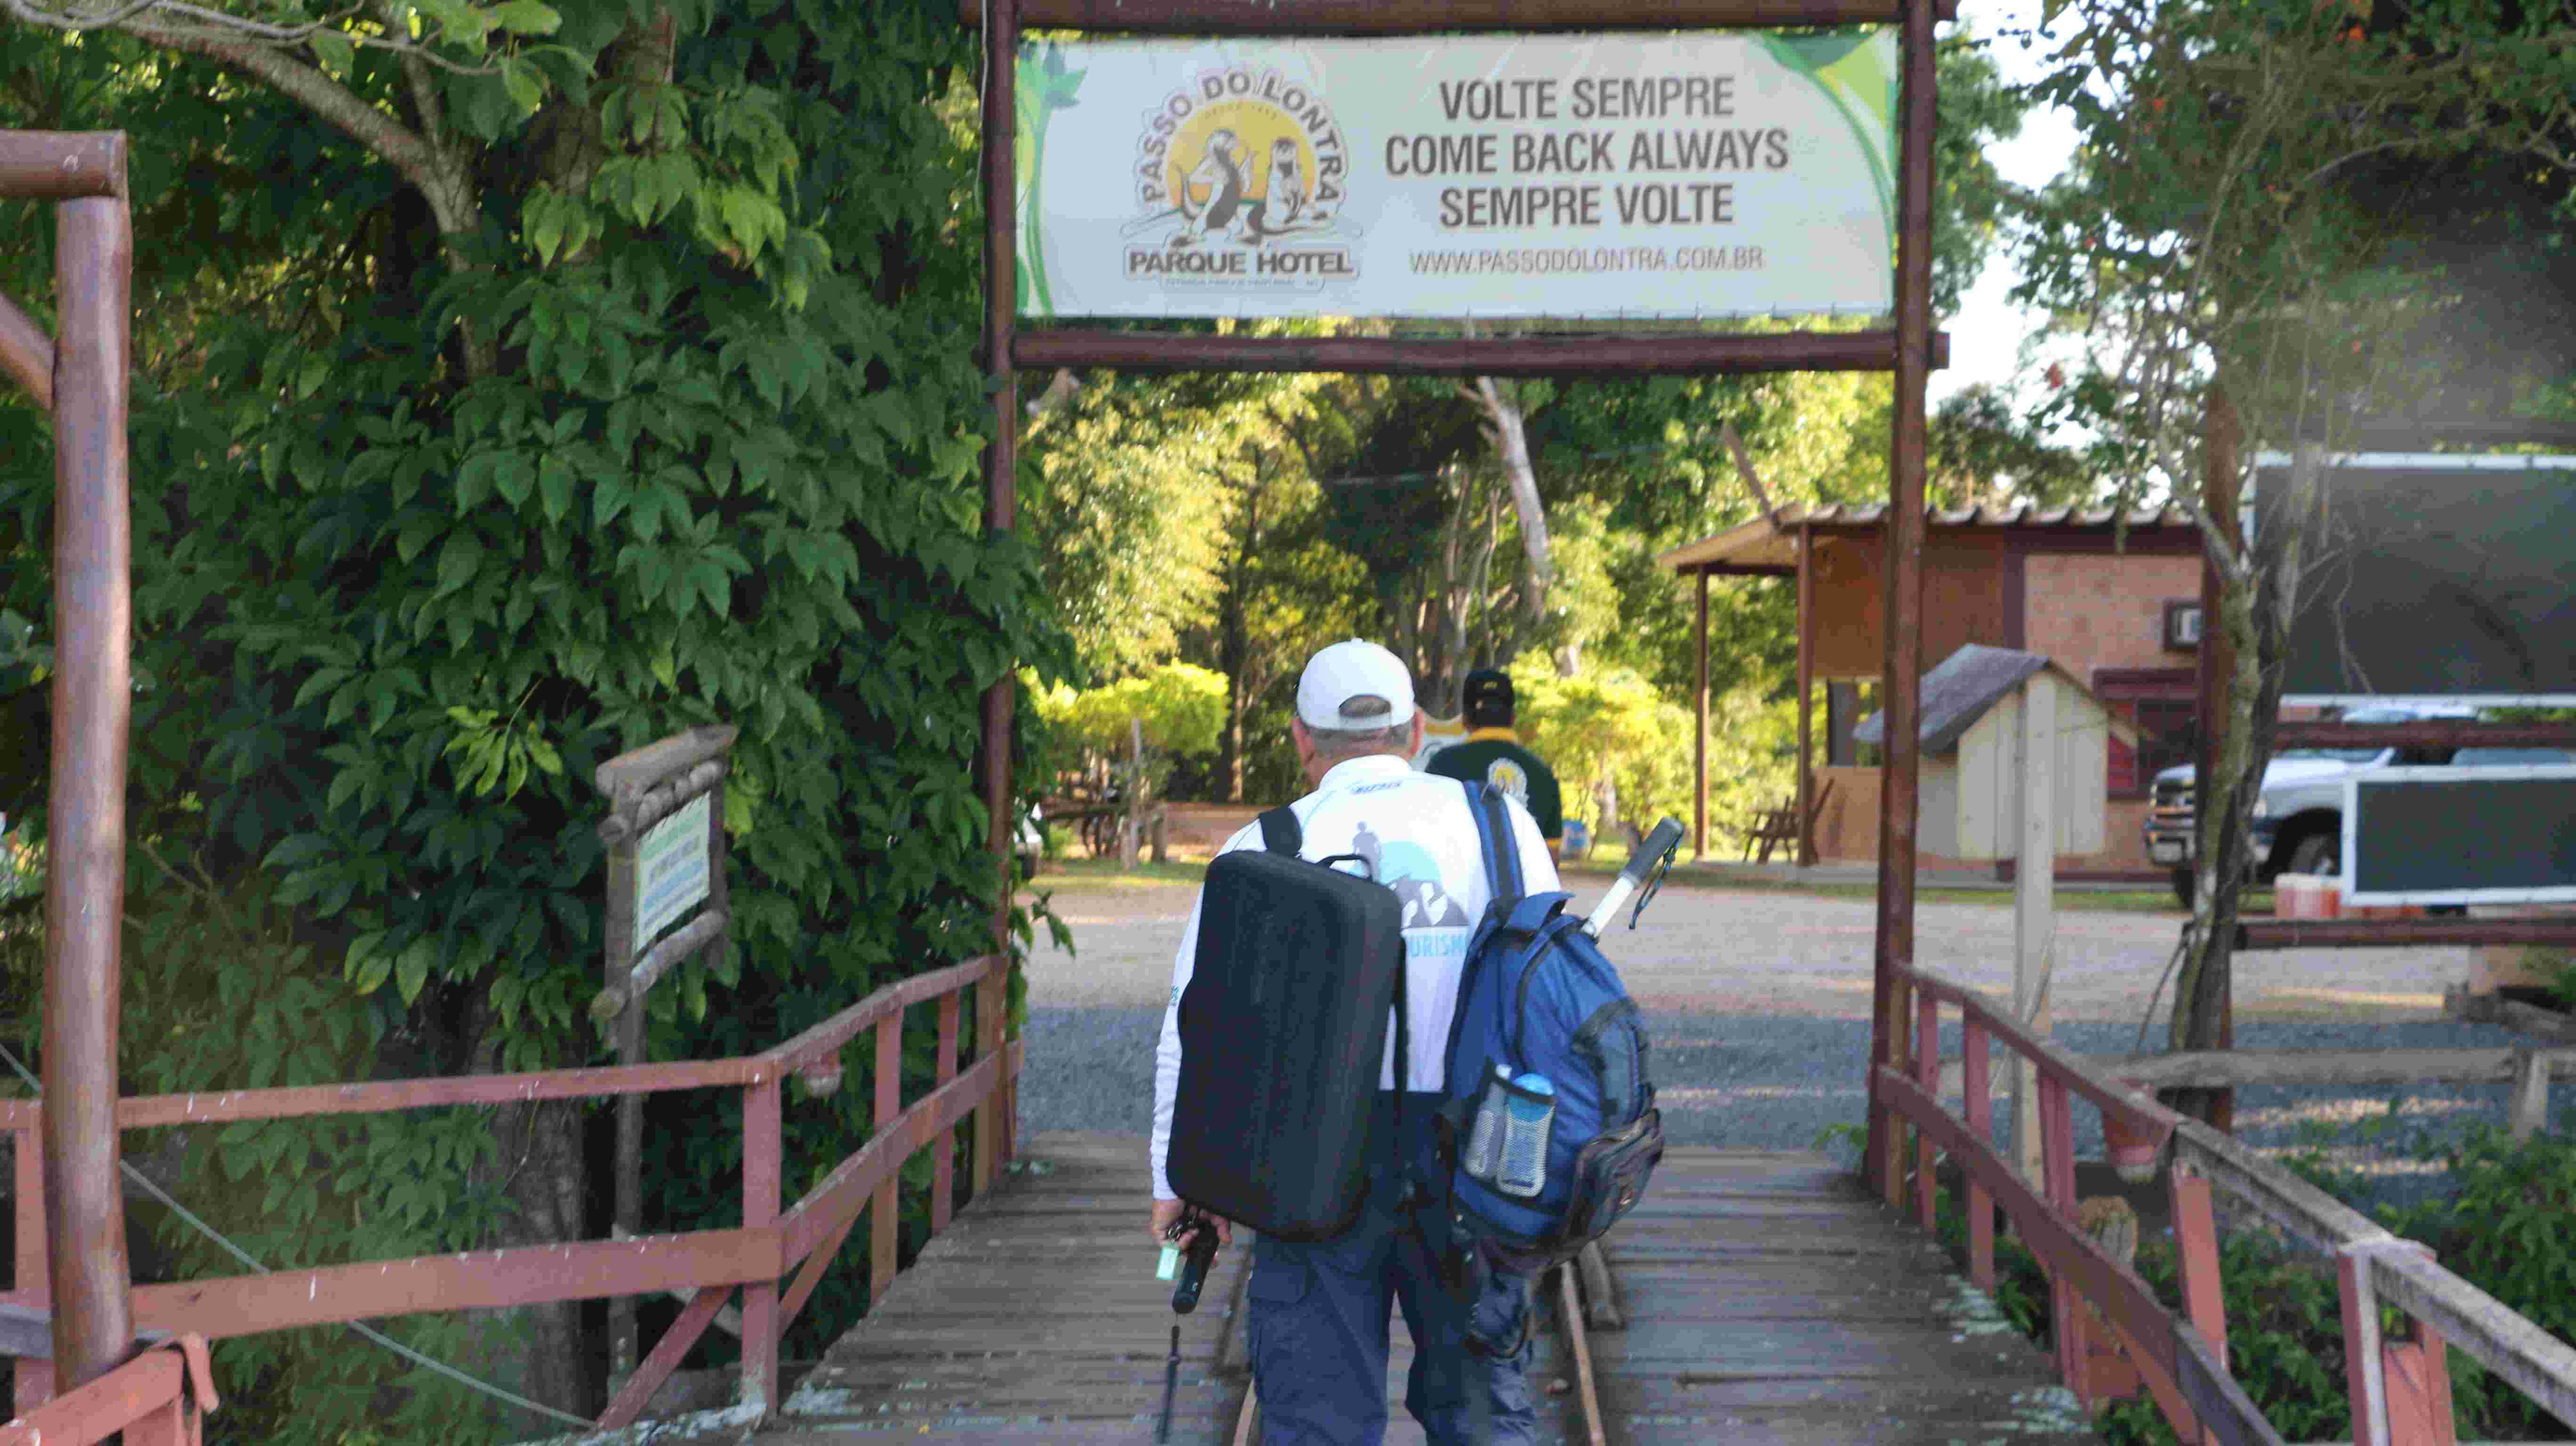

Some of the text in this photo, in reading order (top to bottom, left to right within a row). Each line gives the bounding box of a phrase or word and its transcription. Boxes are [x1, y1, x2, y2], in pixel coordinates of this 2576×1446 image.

[1440, 76, 1734, 120] VOLTE SEMPRE
[1140, 72, 1342, 202] PASSO DO LONTRA
[1385, 128, 1788, 176] COME BACK ALWAYS
[1440, 183, 1733, 227] SEMPRE VOLTE
[1130, 251, 1354, 273] PARQUE HOTEL
[1410, 247, 1763, 274] WWW.PASSODOLONTRA.COM.BR
[1407, 935, 1469, 957] URISM
